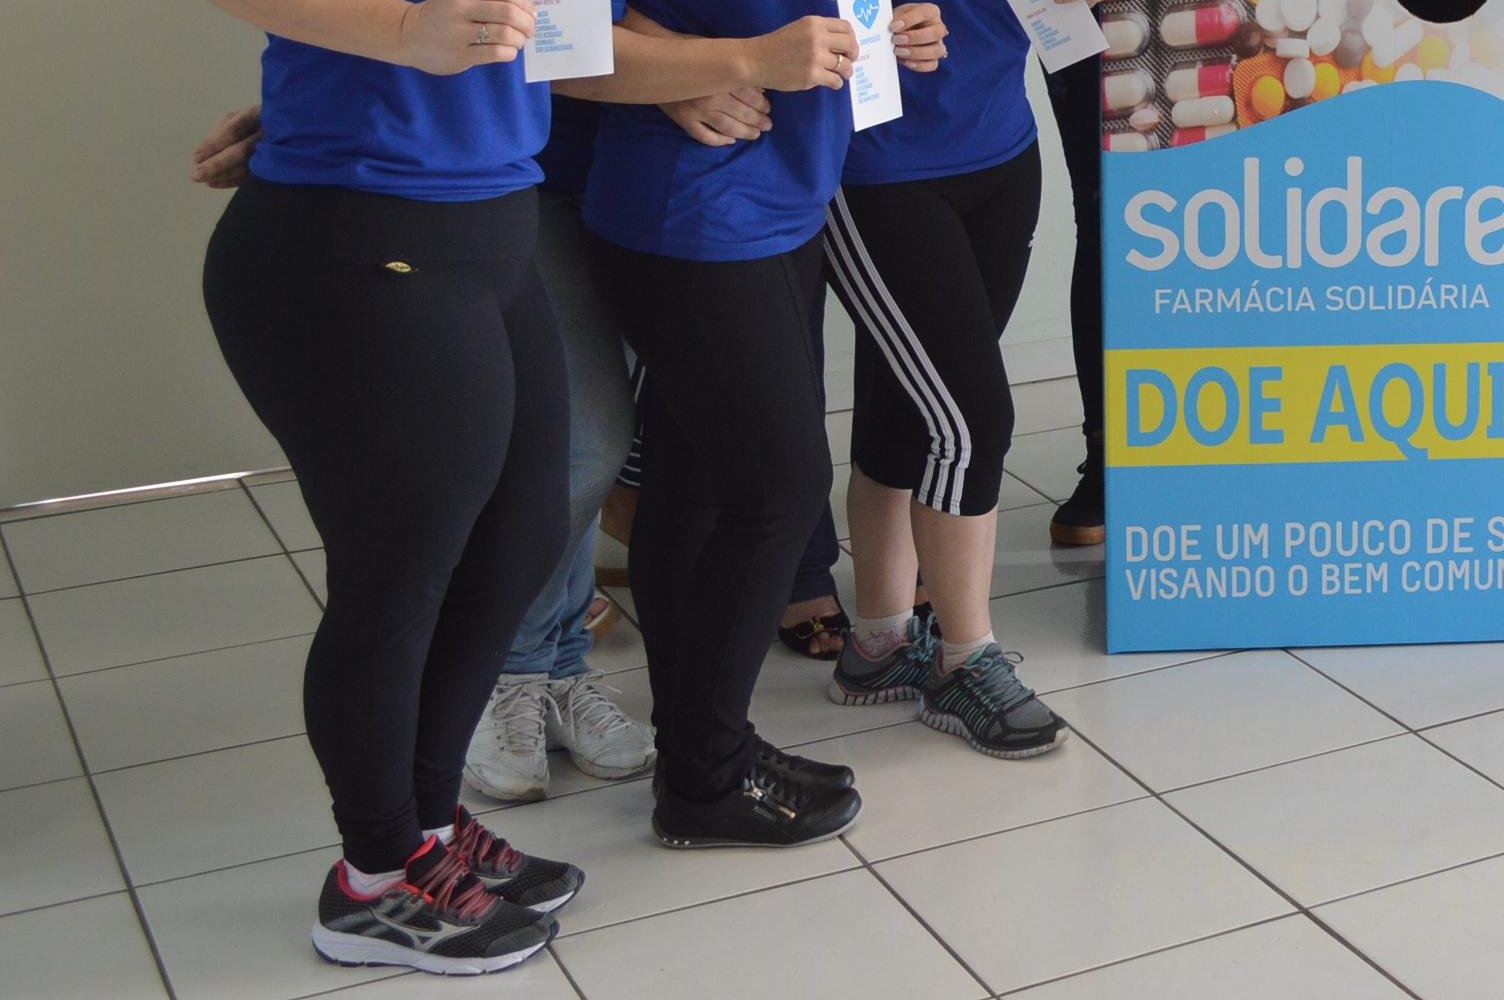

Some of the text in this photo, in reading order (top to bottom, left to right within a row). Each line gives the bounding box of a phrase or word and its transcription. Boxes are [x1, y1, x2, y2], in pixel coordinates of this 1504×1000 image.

[1154, 277, 1491, 314] FARMÁCIA SOLIDÁRIA
[1125, 365, 1285, 449] DOE
[1125, 523, 1203, 563] DOE
[1216, 522, 1270, 560] UM
[1284, 519, 1412, 559] POUCO
[1426, 517, 1475, 554] DE
[1125, 566, 1276, 601] VISANDO
[1287, 563, 1309, 597] O
[1320, 561, 1389, 596] BEM
